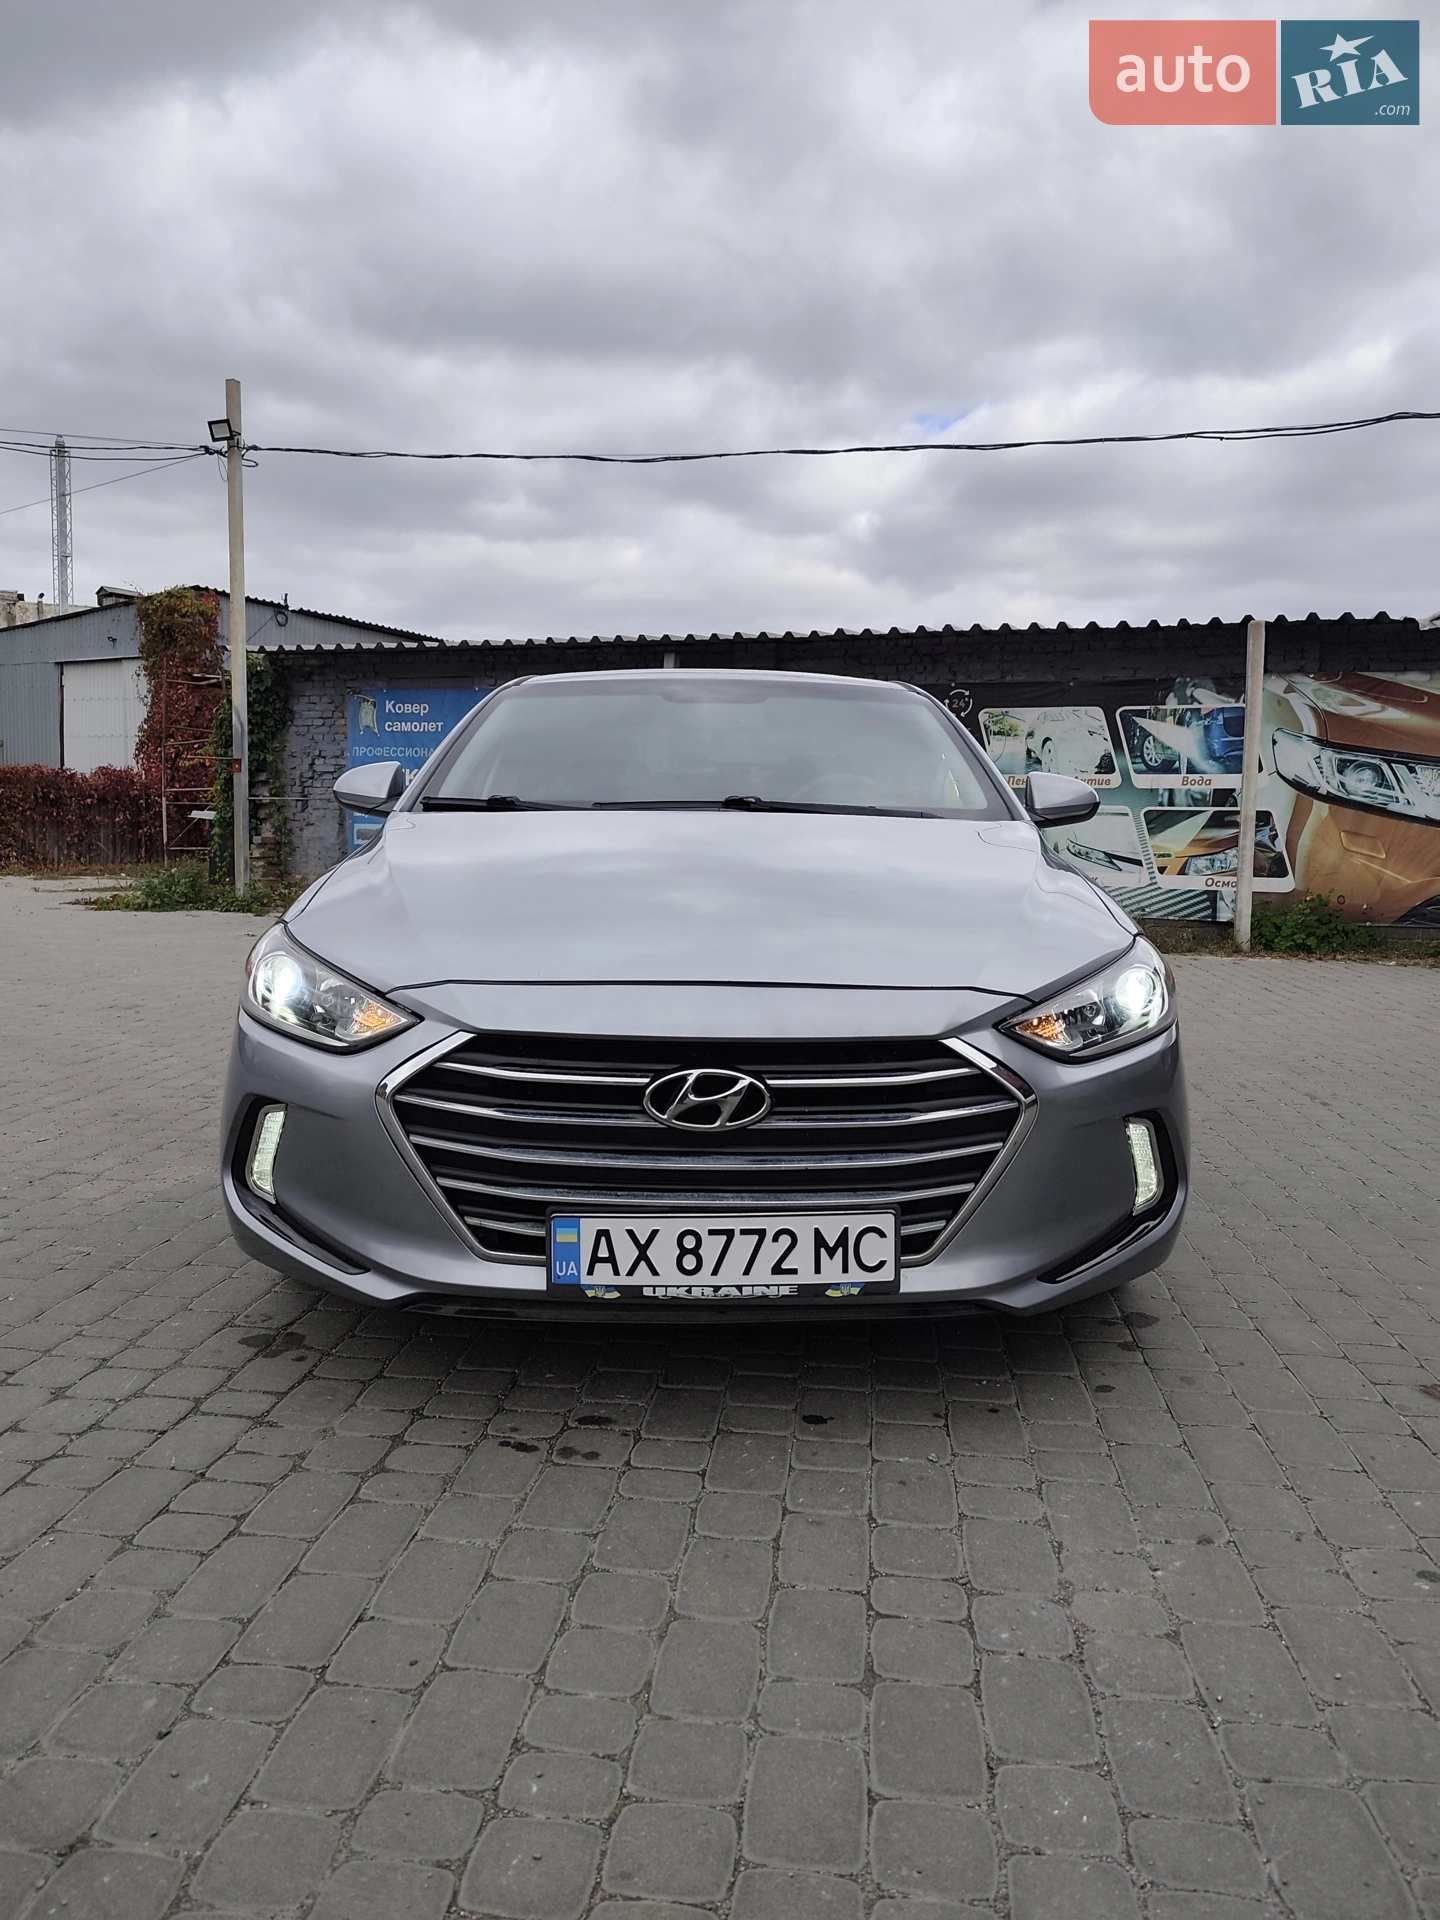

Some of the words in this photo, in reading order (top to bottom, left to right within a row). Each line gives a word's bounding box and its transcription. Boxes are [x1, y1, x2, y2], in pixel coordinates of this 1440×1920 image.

[385, 701, 429, 716] Ковер
[384, 721, 444, 732] самолет
[352, 746, 435, 758] ПРОФЕССИОНА
[1007, 775, 1027, 786] Пен
[1181, 775, 1213, 787] Вода
[1204, 877, 1238, 889] Осмо
[586, 1227, 661, 1277] AX
[674, 1226, 799, 1277] 8772
[813, 1224, 889, 1275] MC
[556, 1260, 579, 1277] UA
[642, 1285, 799, 1298] UKRAINE
